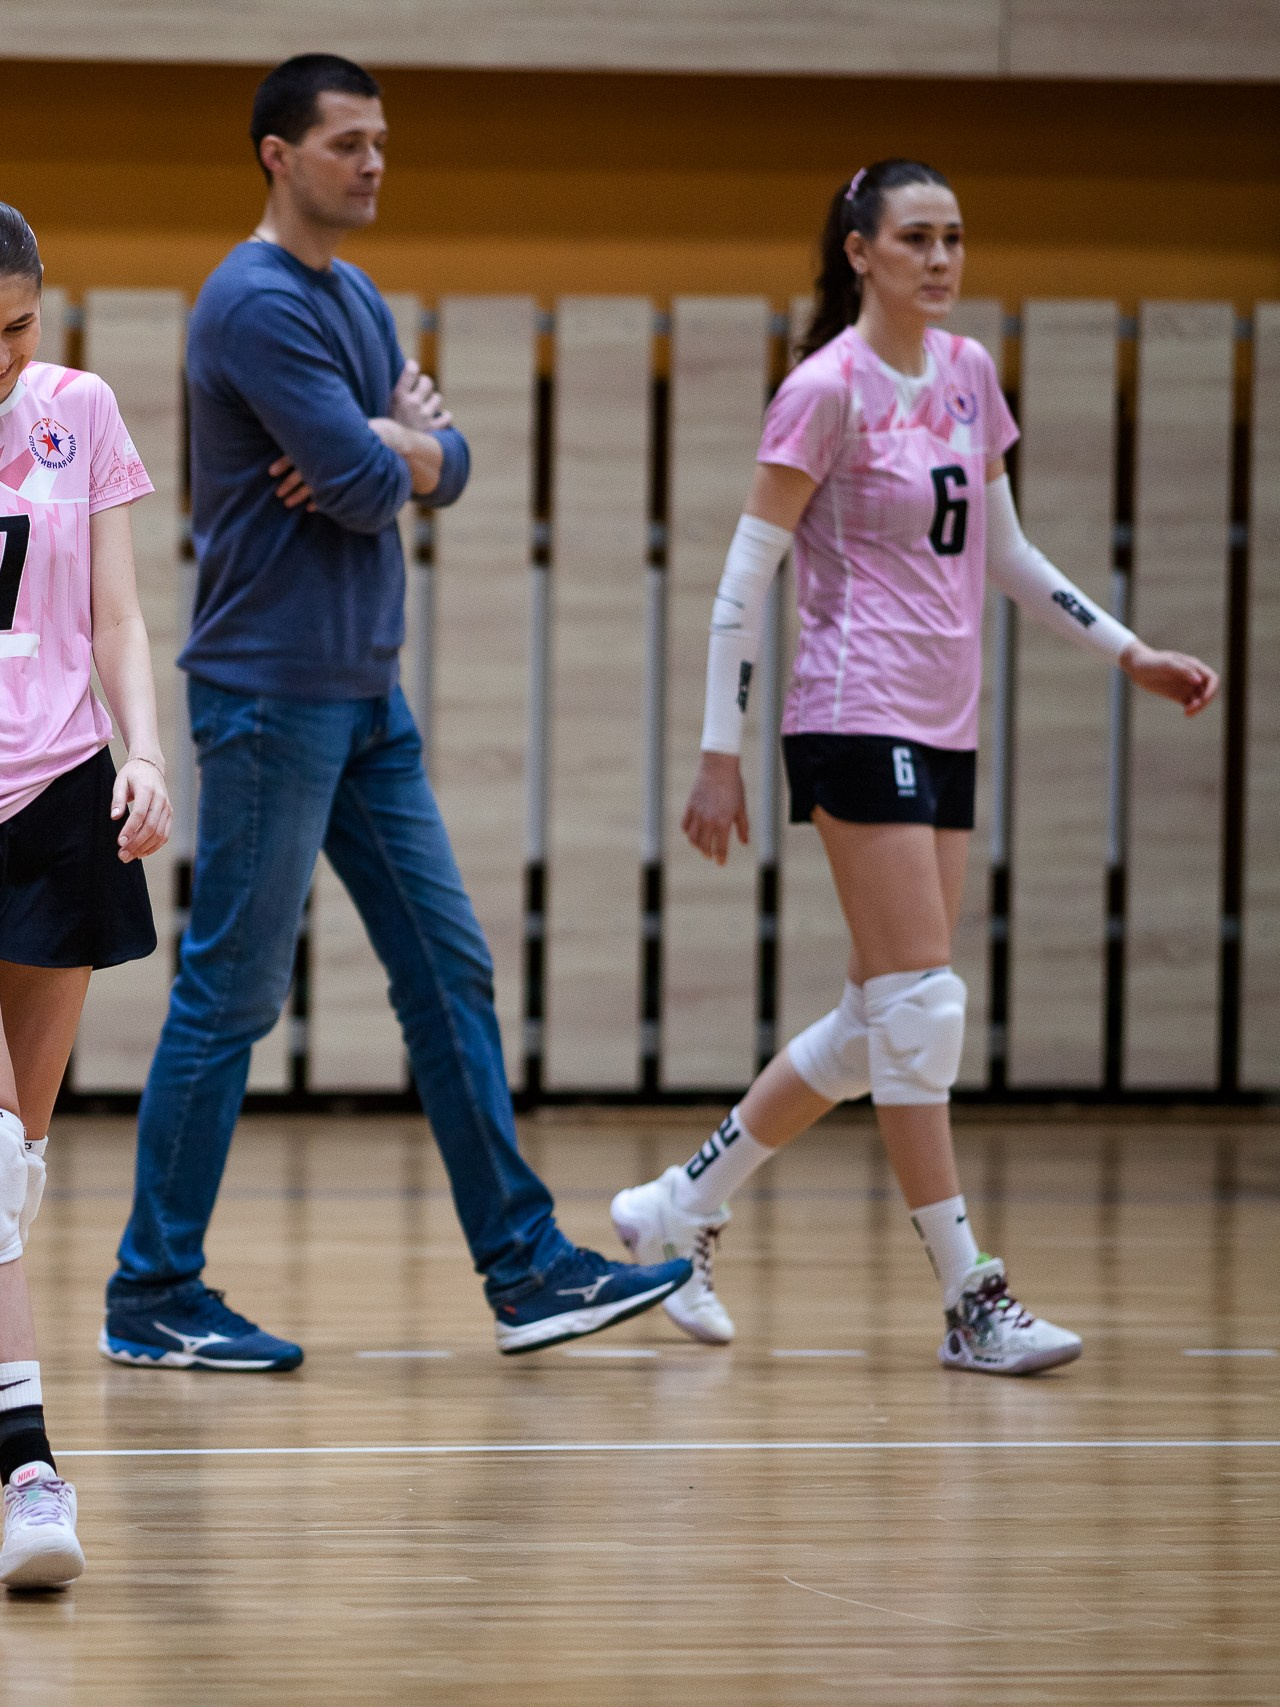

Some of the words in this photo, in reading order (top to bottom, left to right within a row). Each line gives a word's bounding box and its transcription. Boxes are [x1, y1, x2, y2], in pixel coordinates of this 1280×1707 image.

[29, 435, 67, 469] СПОРТИВНАЯ
[65, 434, 77, 464] ШКОЛА
[928, 465, 968, 556] 6
[892, 746, 915, 786] 6
[17, 1467, 37, 1483] NIKE
